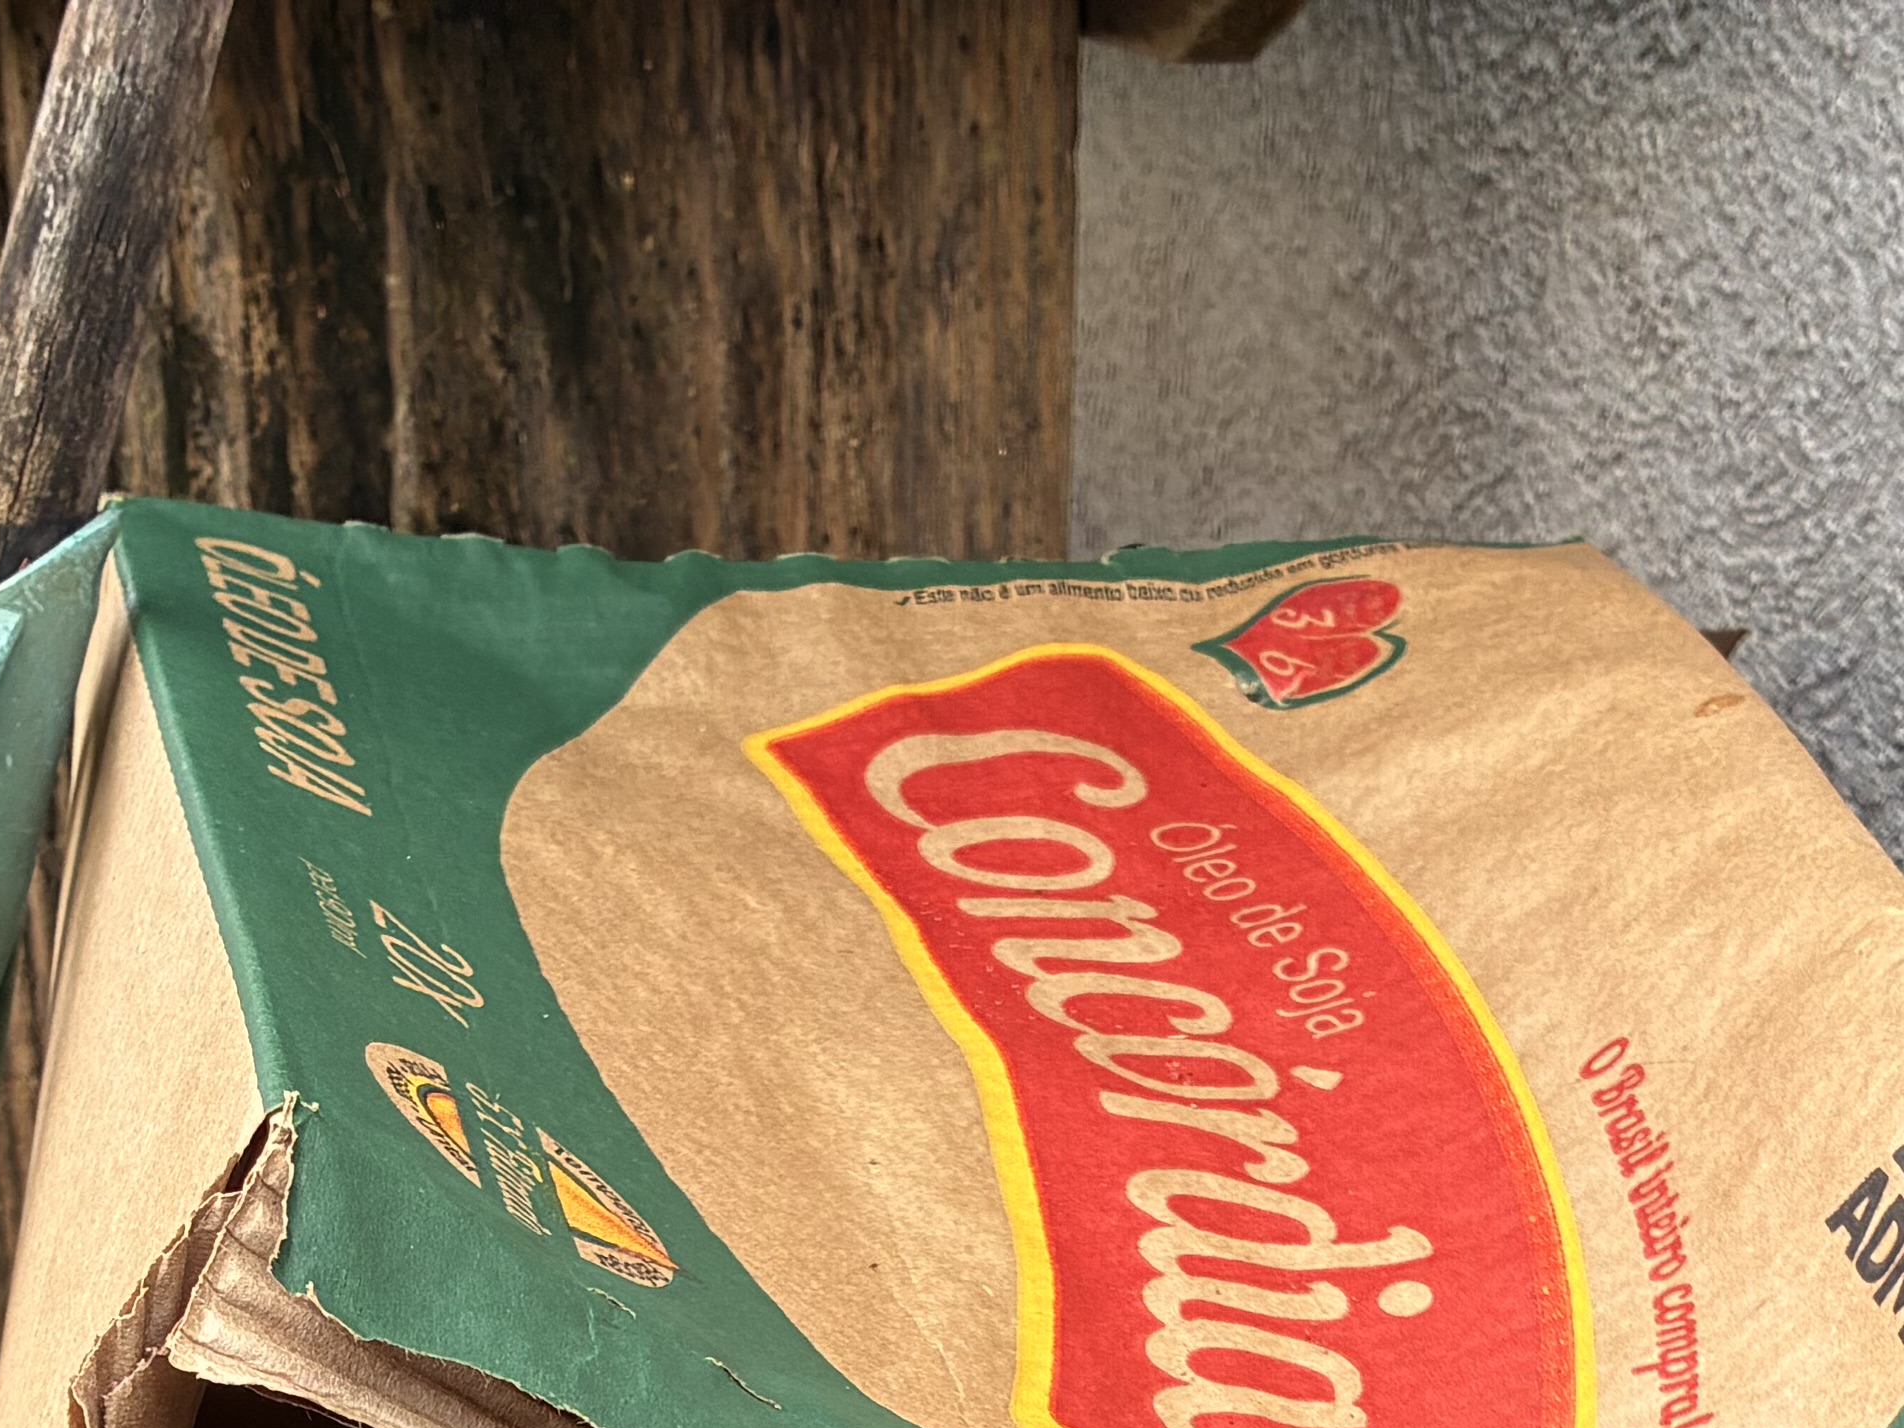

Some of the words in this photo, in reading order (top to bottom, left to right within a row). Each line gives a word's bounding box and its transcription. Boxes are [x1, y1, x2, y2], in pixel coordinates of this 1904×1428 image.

[195, 537, 322, 641] ÓLEO
[1049, 580, 1123, 601] alimento
[222, 617, 338, 705] DE
[239, 676, 373, 816] SOJA
[1150, 821, 1257, 901] Óleo
[1229, 903, 1308, 948] de
[1271, 947, 1378, 1040] Soja
[1578, 1036, 1630, 1081] O
[1590, 1062, 1672, 1178] Brasil
[1627, 1160, 1690, 1283] inteiro
